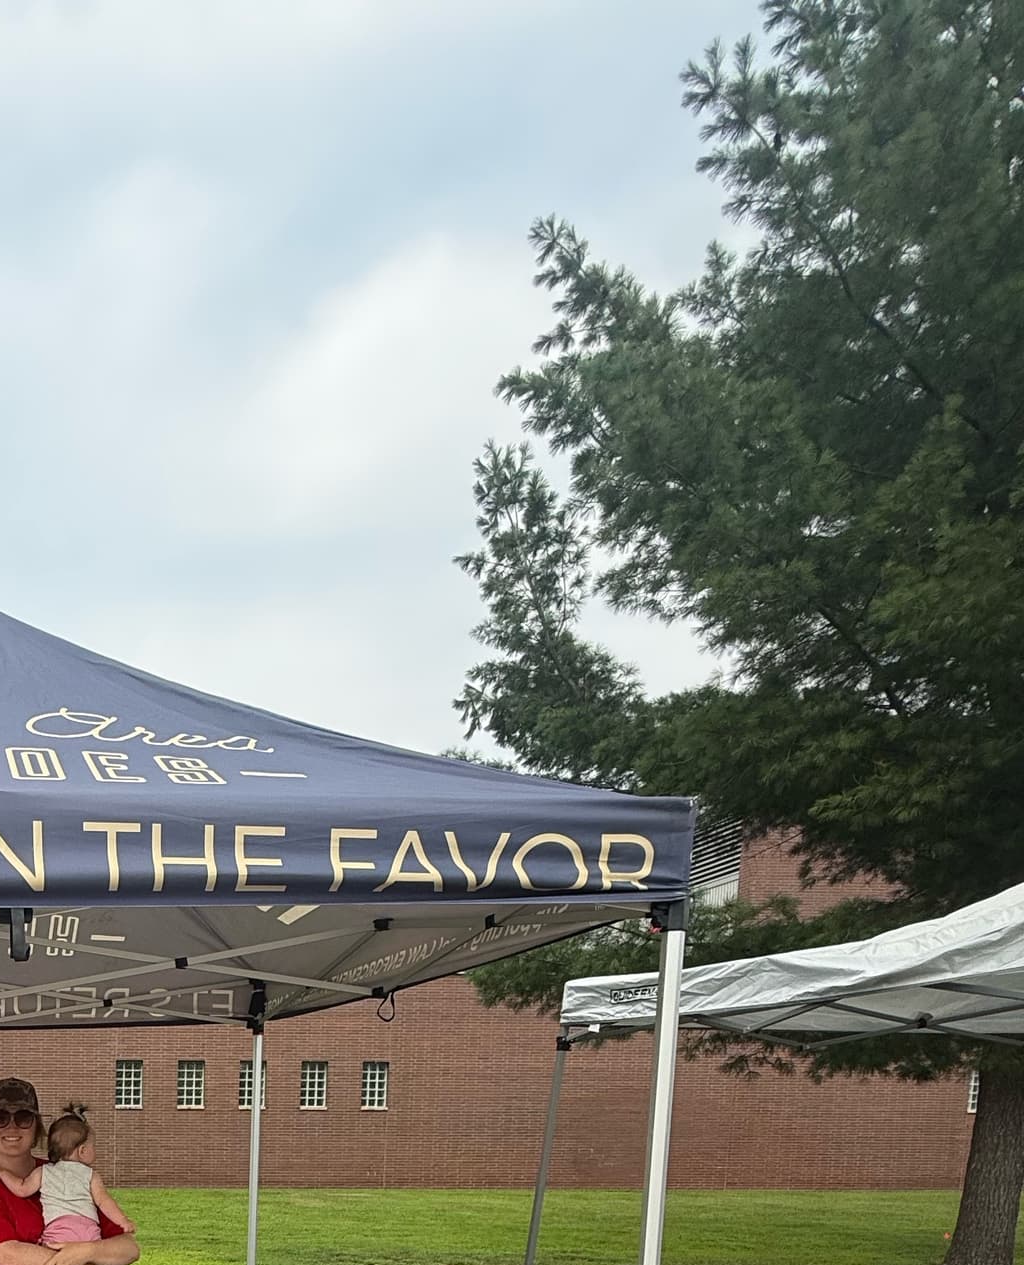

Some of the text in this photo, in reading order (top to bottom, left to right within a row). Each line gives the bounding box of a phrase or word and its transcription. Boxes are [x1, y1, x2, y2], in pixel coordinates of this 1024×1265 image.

[25, 707, 274, 754] Area
[83, 820, 287, 892] THE
[328, 827, 655, 893] FAVOR
